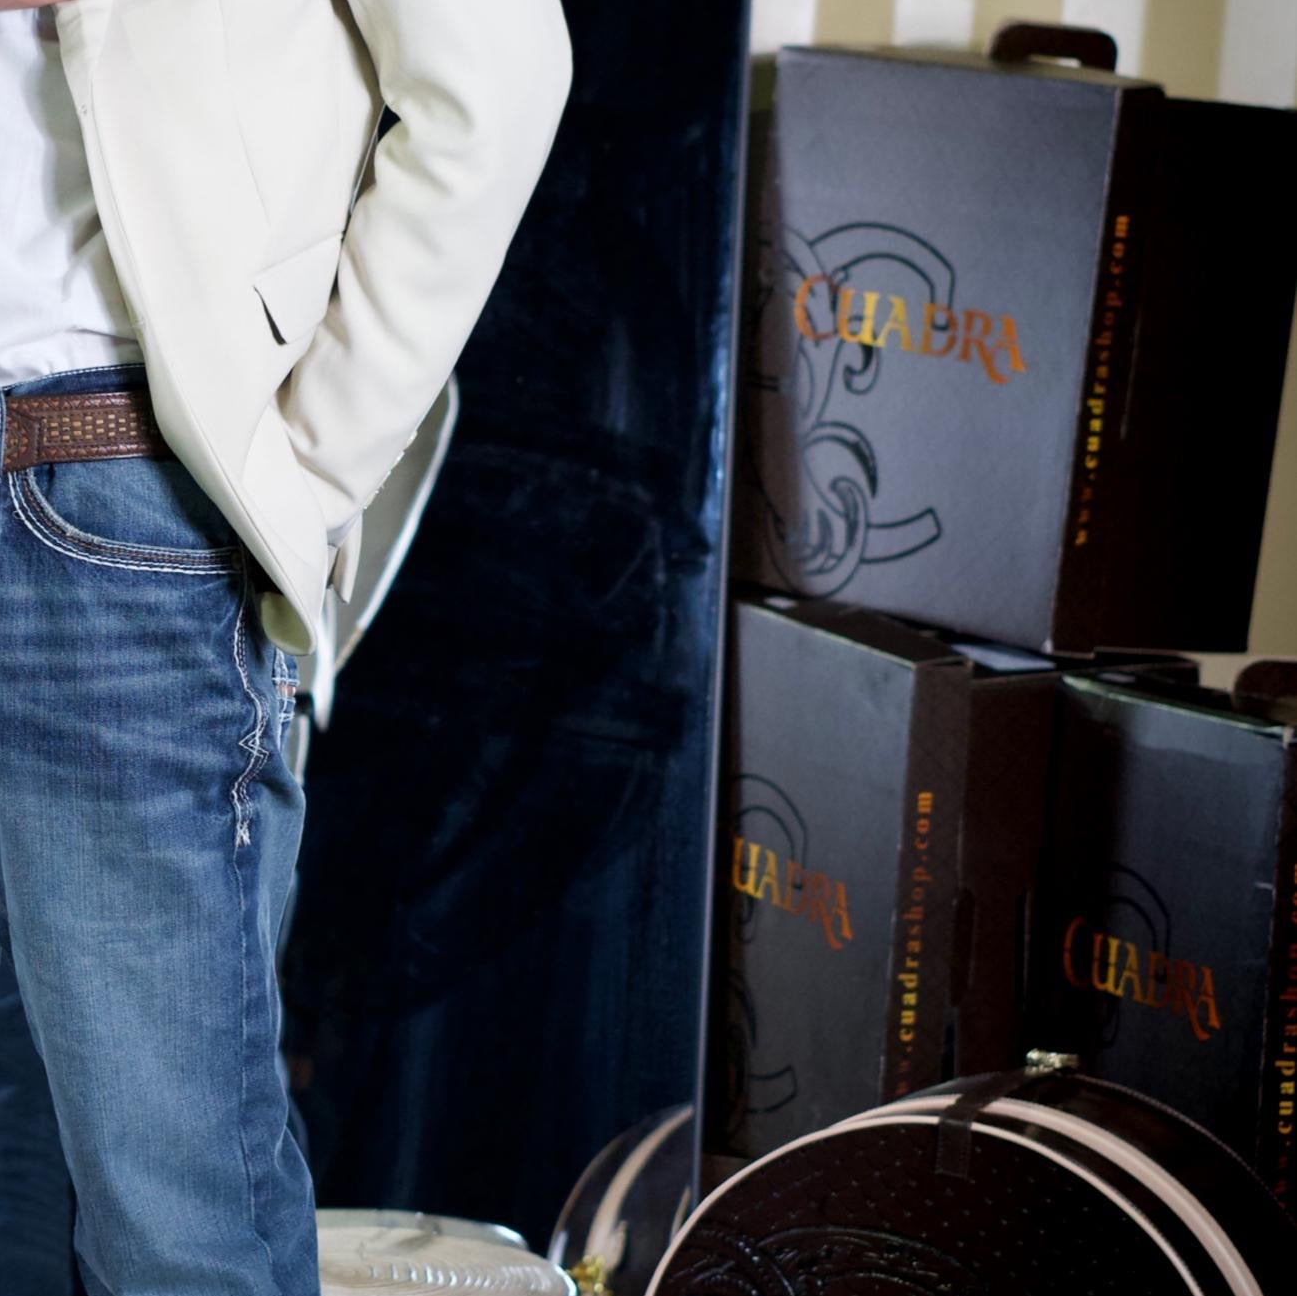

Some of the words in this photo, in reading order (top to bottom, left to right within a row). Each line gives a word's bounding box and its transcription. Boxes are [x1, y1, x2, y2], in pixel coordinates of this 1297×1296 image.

[794, 274, 1028, 386] CUADRA
[731, 834, 853, 952] UADRA
[1062, 915, 1222, 1043] CUADRA
